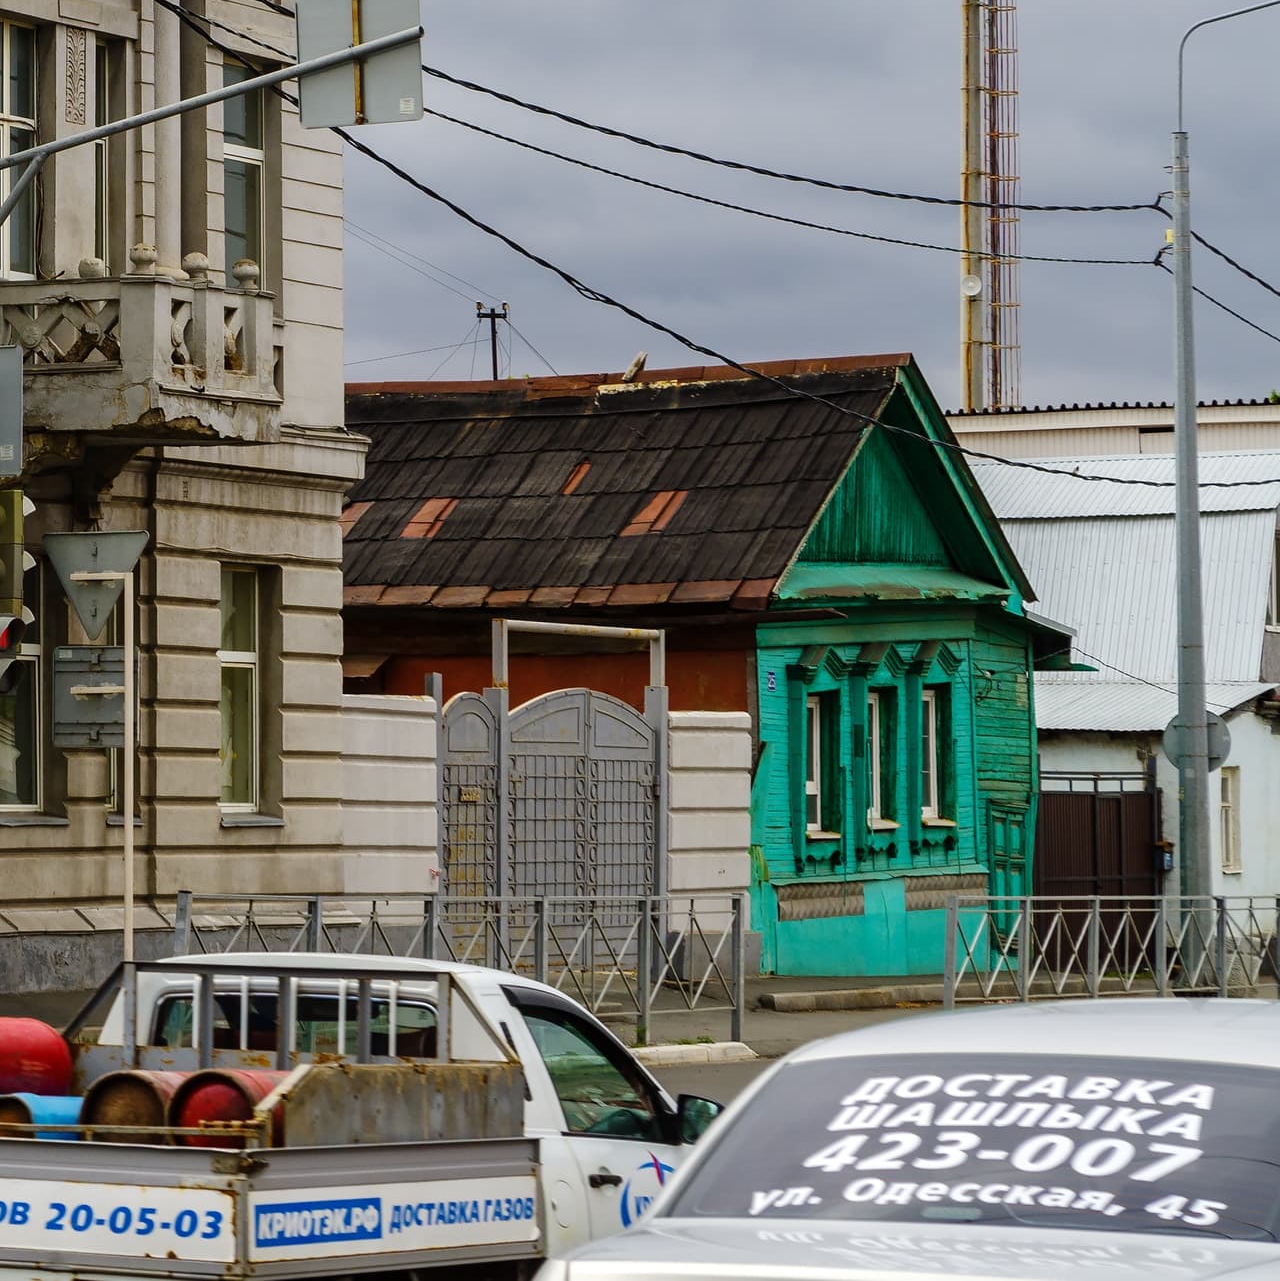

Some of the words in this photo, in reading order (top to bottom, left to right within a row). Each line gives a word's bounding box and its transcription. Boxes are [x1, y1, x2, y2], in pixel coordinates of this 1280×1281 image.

[840, 1074, 1215, 1111] ДОСТАВКА
[826, 1101, 1203, 1142] ШАШЛЫКА
[802, 1131, 1205, 1183] 423-007
[45, 1202, 223, 1240] 20-05-03
[257, 1205, 379, 1241] КРИОТЭК.РФ
[390, 1200, 479, 1233] ДОСТАВКА
[483, 1197, 534, 1223] ГАЗОВ
[748, 1186, 824, 1216] ул.
[842, 1178, 1127, 1216] Одесская,
[1144, 1194, 1228, 1226] 45
